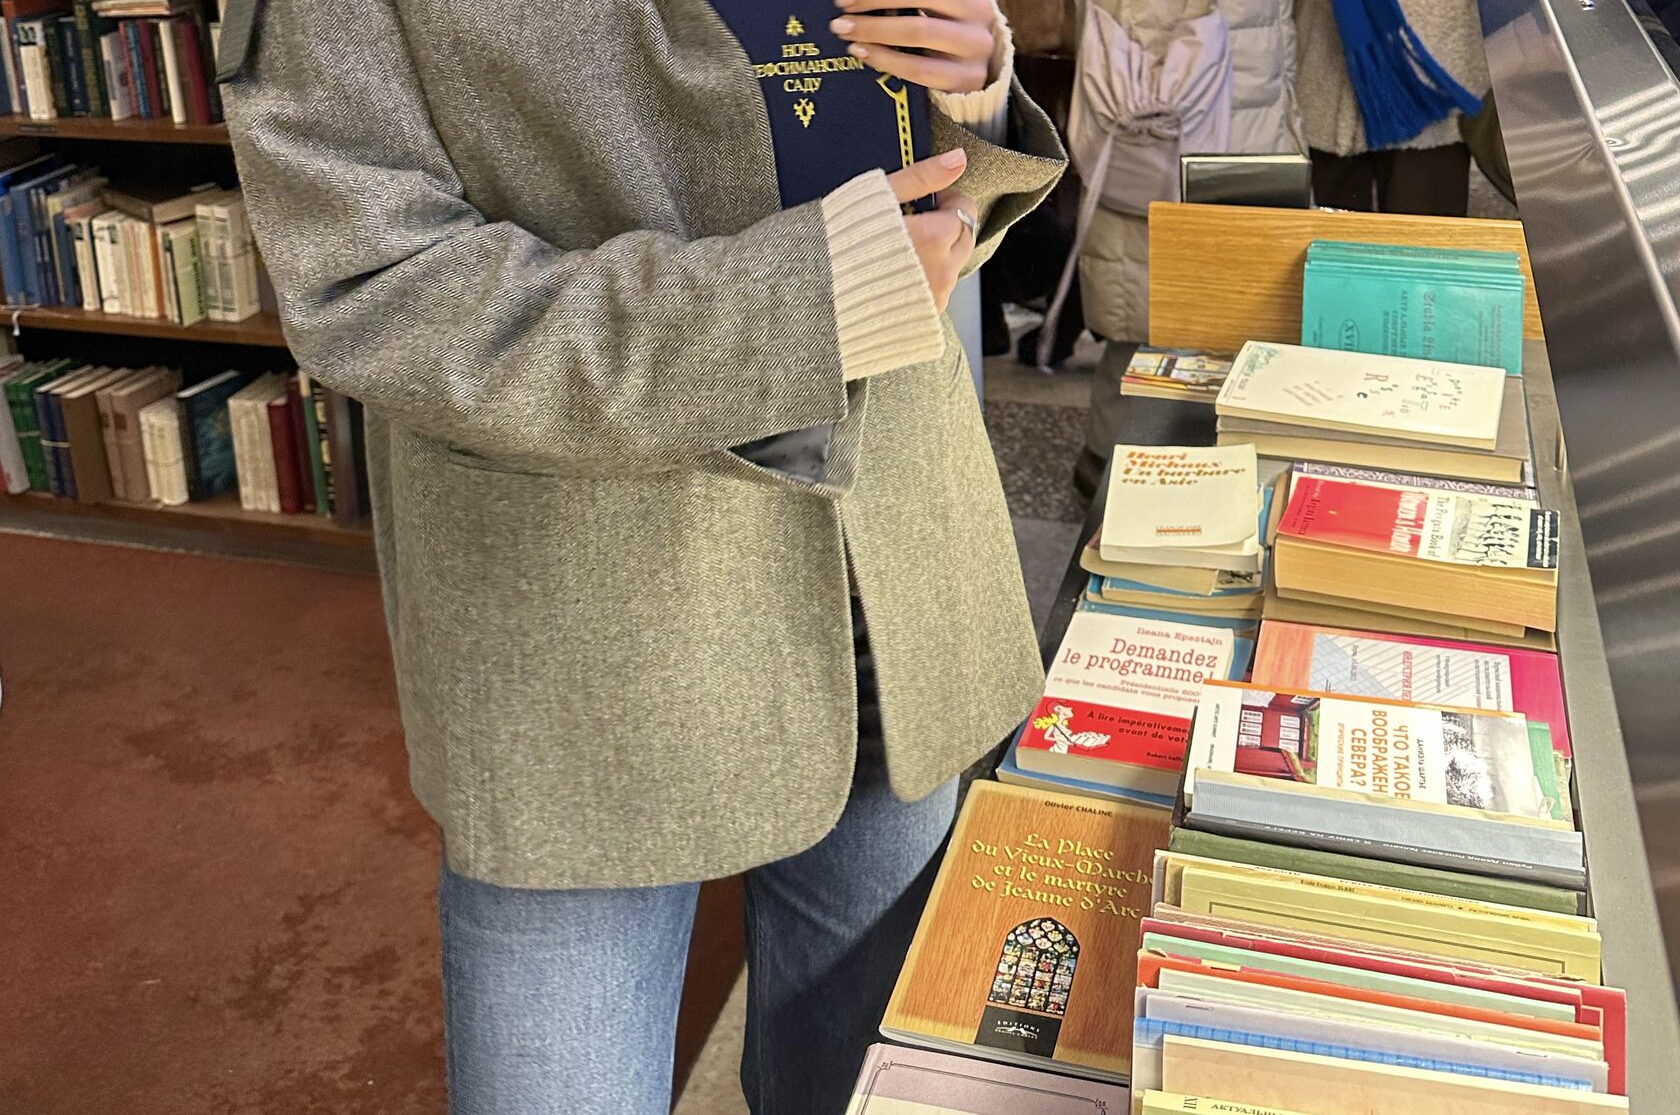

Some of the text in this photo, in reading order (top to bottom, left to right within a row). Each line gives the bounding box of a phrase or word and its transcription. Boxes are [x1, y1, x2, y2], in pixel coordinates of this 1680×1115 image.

[781, 43, 820, 58] НОЧЬ
[752, 57, 865, 78] ЕФСИМАНСКОМ
[783, 77, 822, 93] САДУ
[1126, 451, 1187, 460] Henri
[1428, 497, 1449, 557] The Penguin Book of
[1136, 627, 1223, 646] Ileana Epsztajn
[1110, 638, 1218, 669] Demandez
[1062, 648, 1081, 665] le
[1085, 653, 1203, 683] programme
[1065, 678, 1080, 687] que
[1081, 678, 1095, 687] les
[1095, 682, 1139, 696] candidats
[1141, 689, 1161, 698] vous
[1182, 688, 1201, 697] 200
[1098, 712, 1114, 722] lire
[1118, 728, 1148, 737] avant
[1151, 730, 1164, 740] de
[1351, 728, 1367, 788] СЕВЕРА?
[1394, 725, 1411, 799] ЧТО ТАКОЕ
[1417, 739, 1425, 765] ДАНИЭЛЬ
[1044, 800, 1114, 818] Olivier CHALINE
[971, 839, 998, 857] du
[1023, 833, 1115, 861] La Place
[993, 863, 1128, 899] et le martyre
[970, 874, 1142, 919] de Jeanne d'Arc
